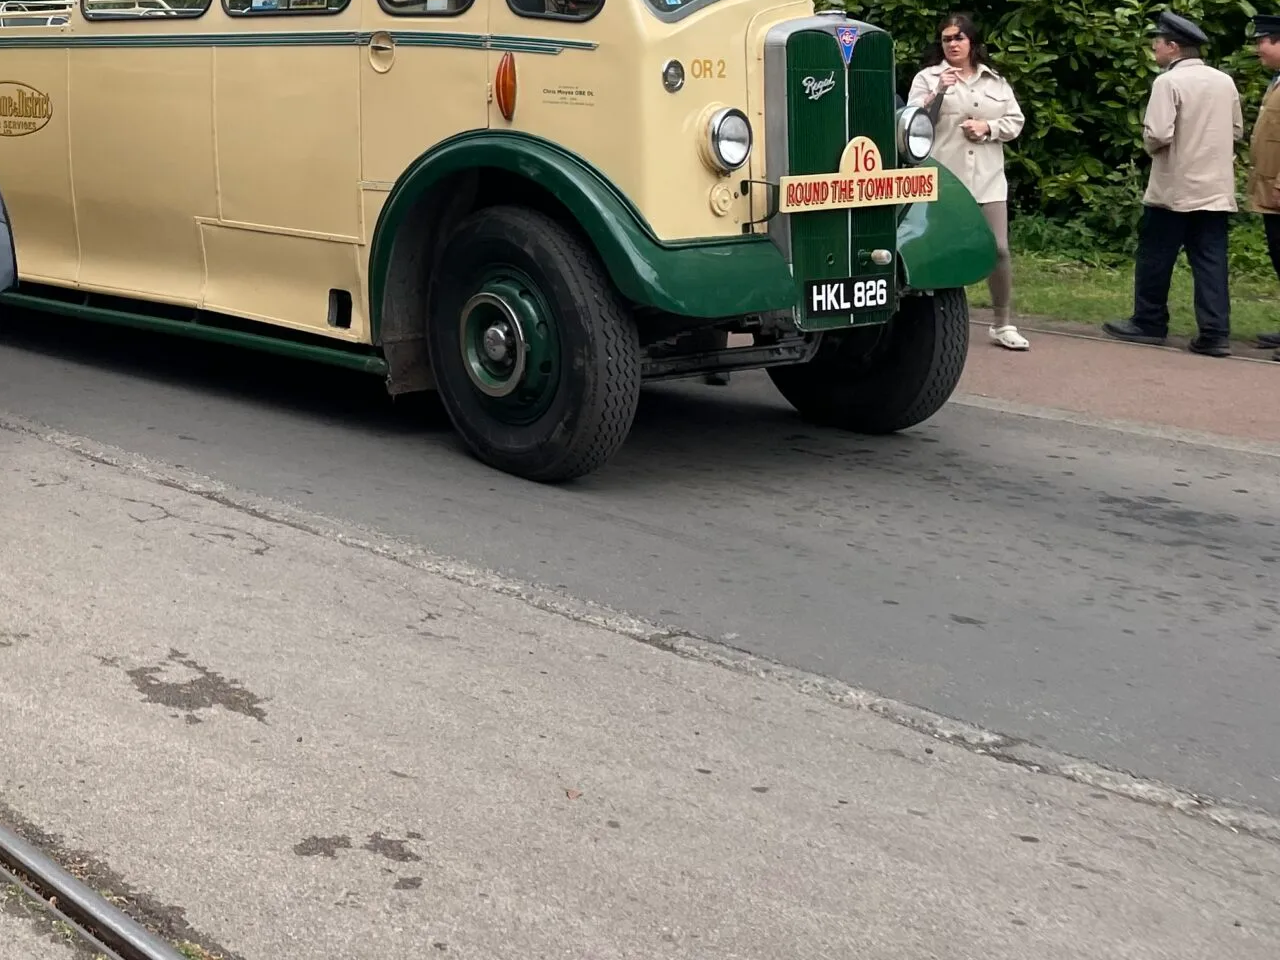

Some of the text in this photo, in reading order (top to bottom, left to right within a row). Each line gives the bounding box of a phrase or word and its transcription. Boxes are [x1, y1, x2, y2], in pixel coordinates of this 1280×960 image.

[691, 59, 726, 79] OR 2
[802, 71, 835, 101] Regal
[16, 89, 50, 119] District
[3, 120, 36, 130] SERVICES
[786, 174, 933, 207] ROUND THE TOWN TOURS
[812, 279, 887, 311] HKL 826
